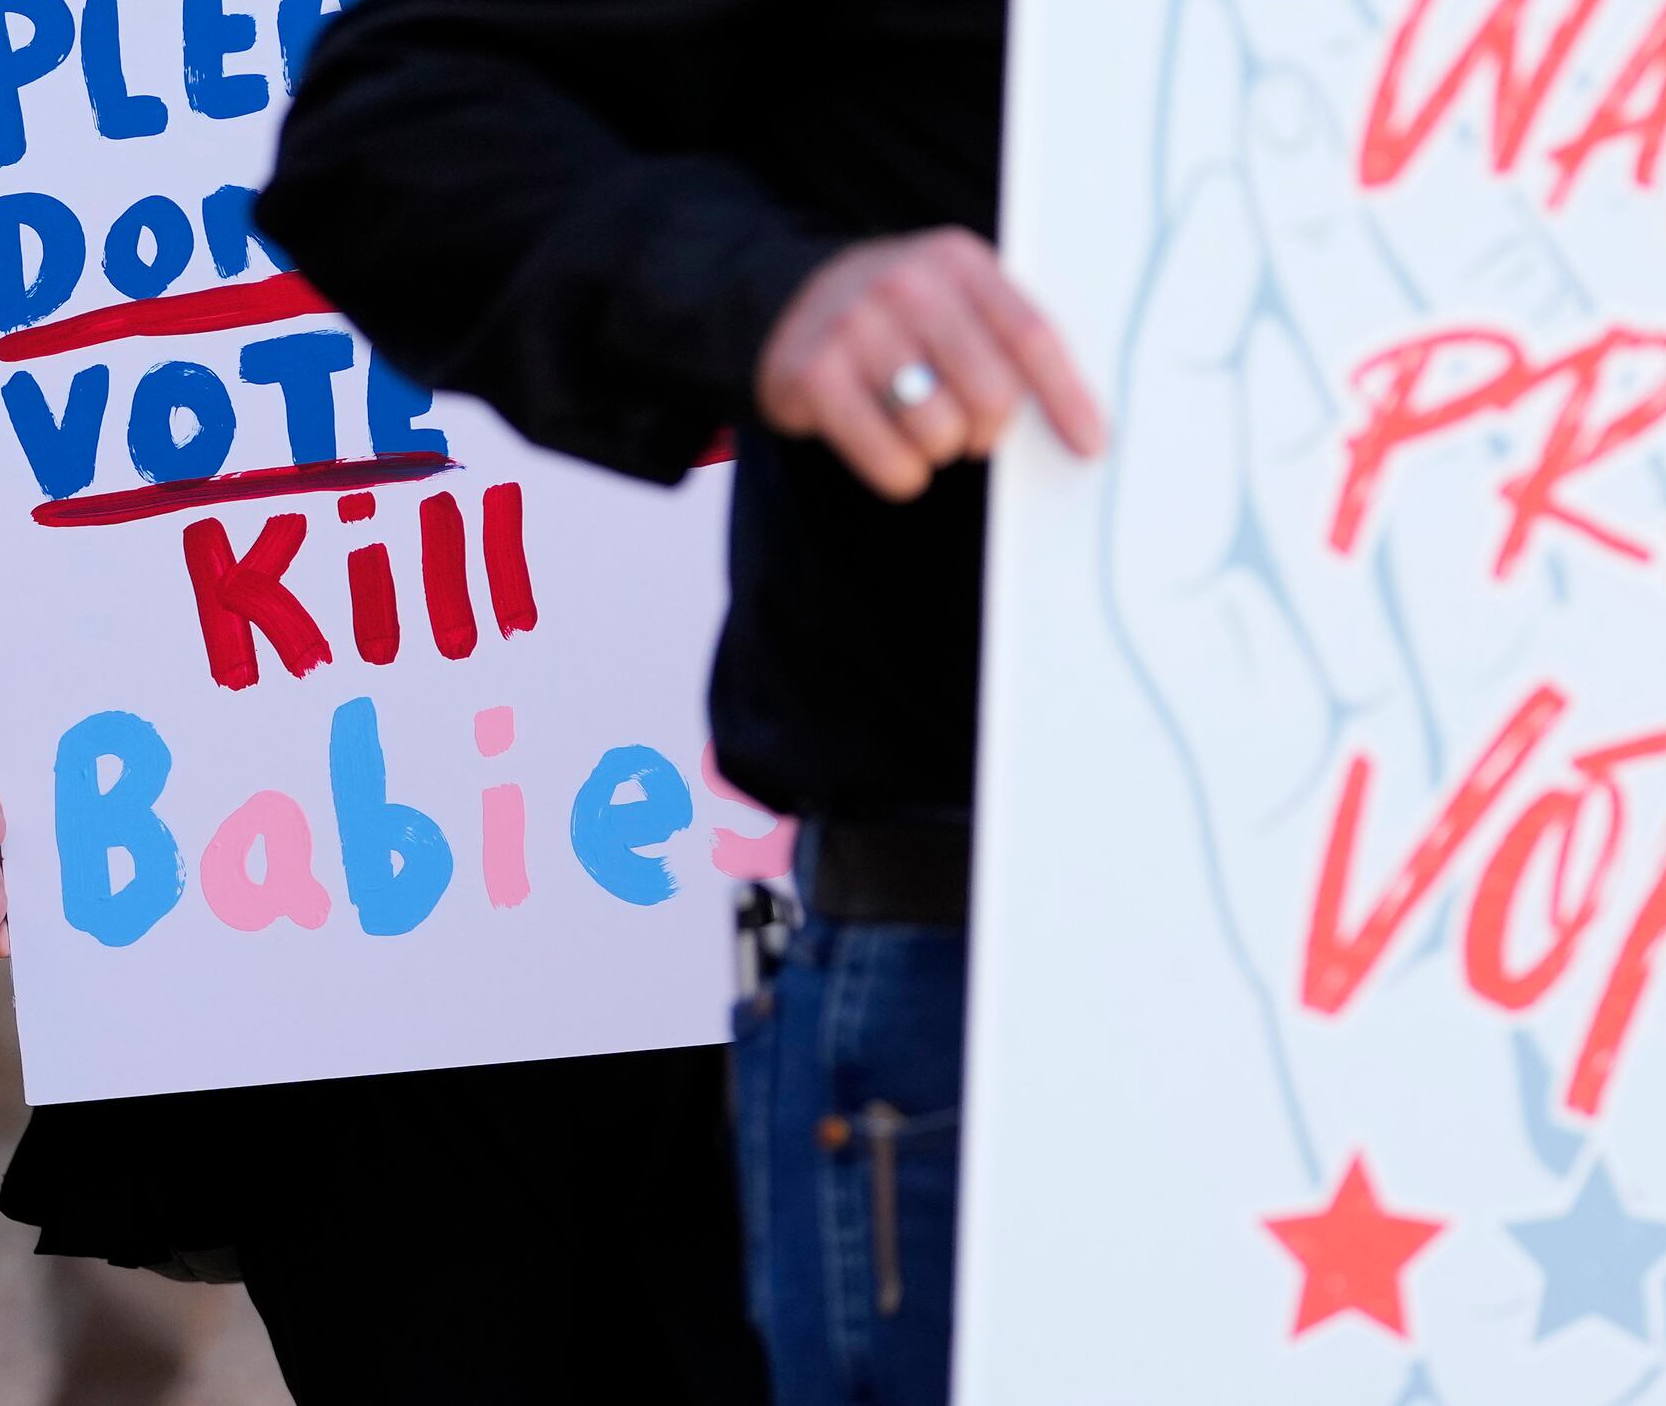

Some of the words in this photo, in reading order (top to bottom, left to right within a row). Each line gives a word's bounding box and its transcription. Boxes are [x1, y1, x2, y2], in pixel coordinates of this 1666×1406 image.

[1, 329, 449, 500] VOTE
[183, 482, 538, 691] Kill
[54, 695, 795, 947] Babies
